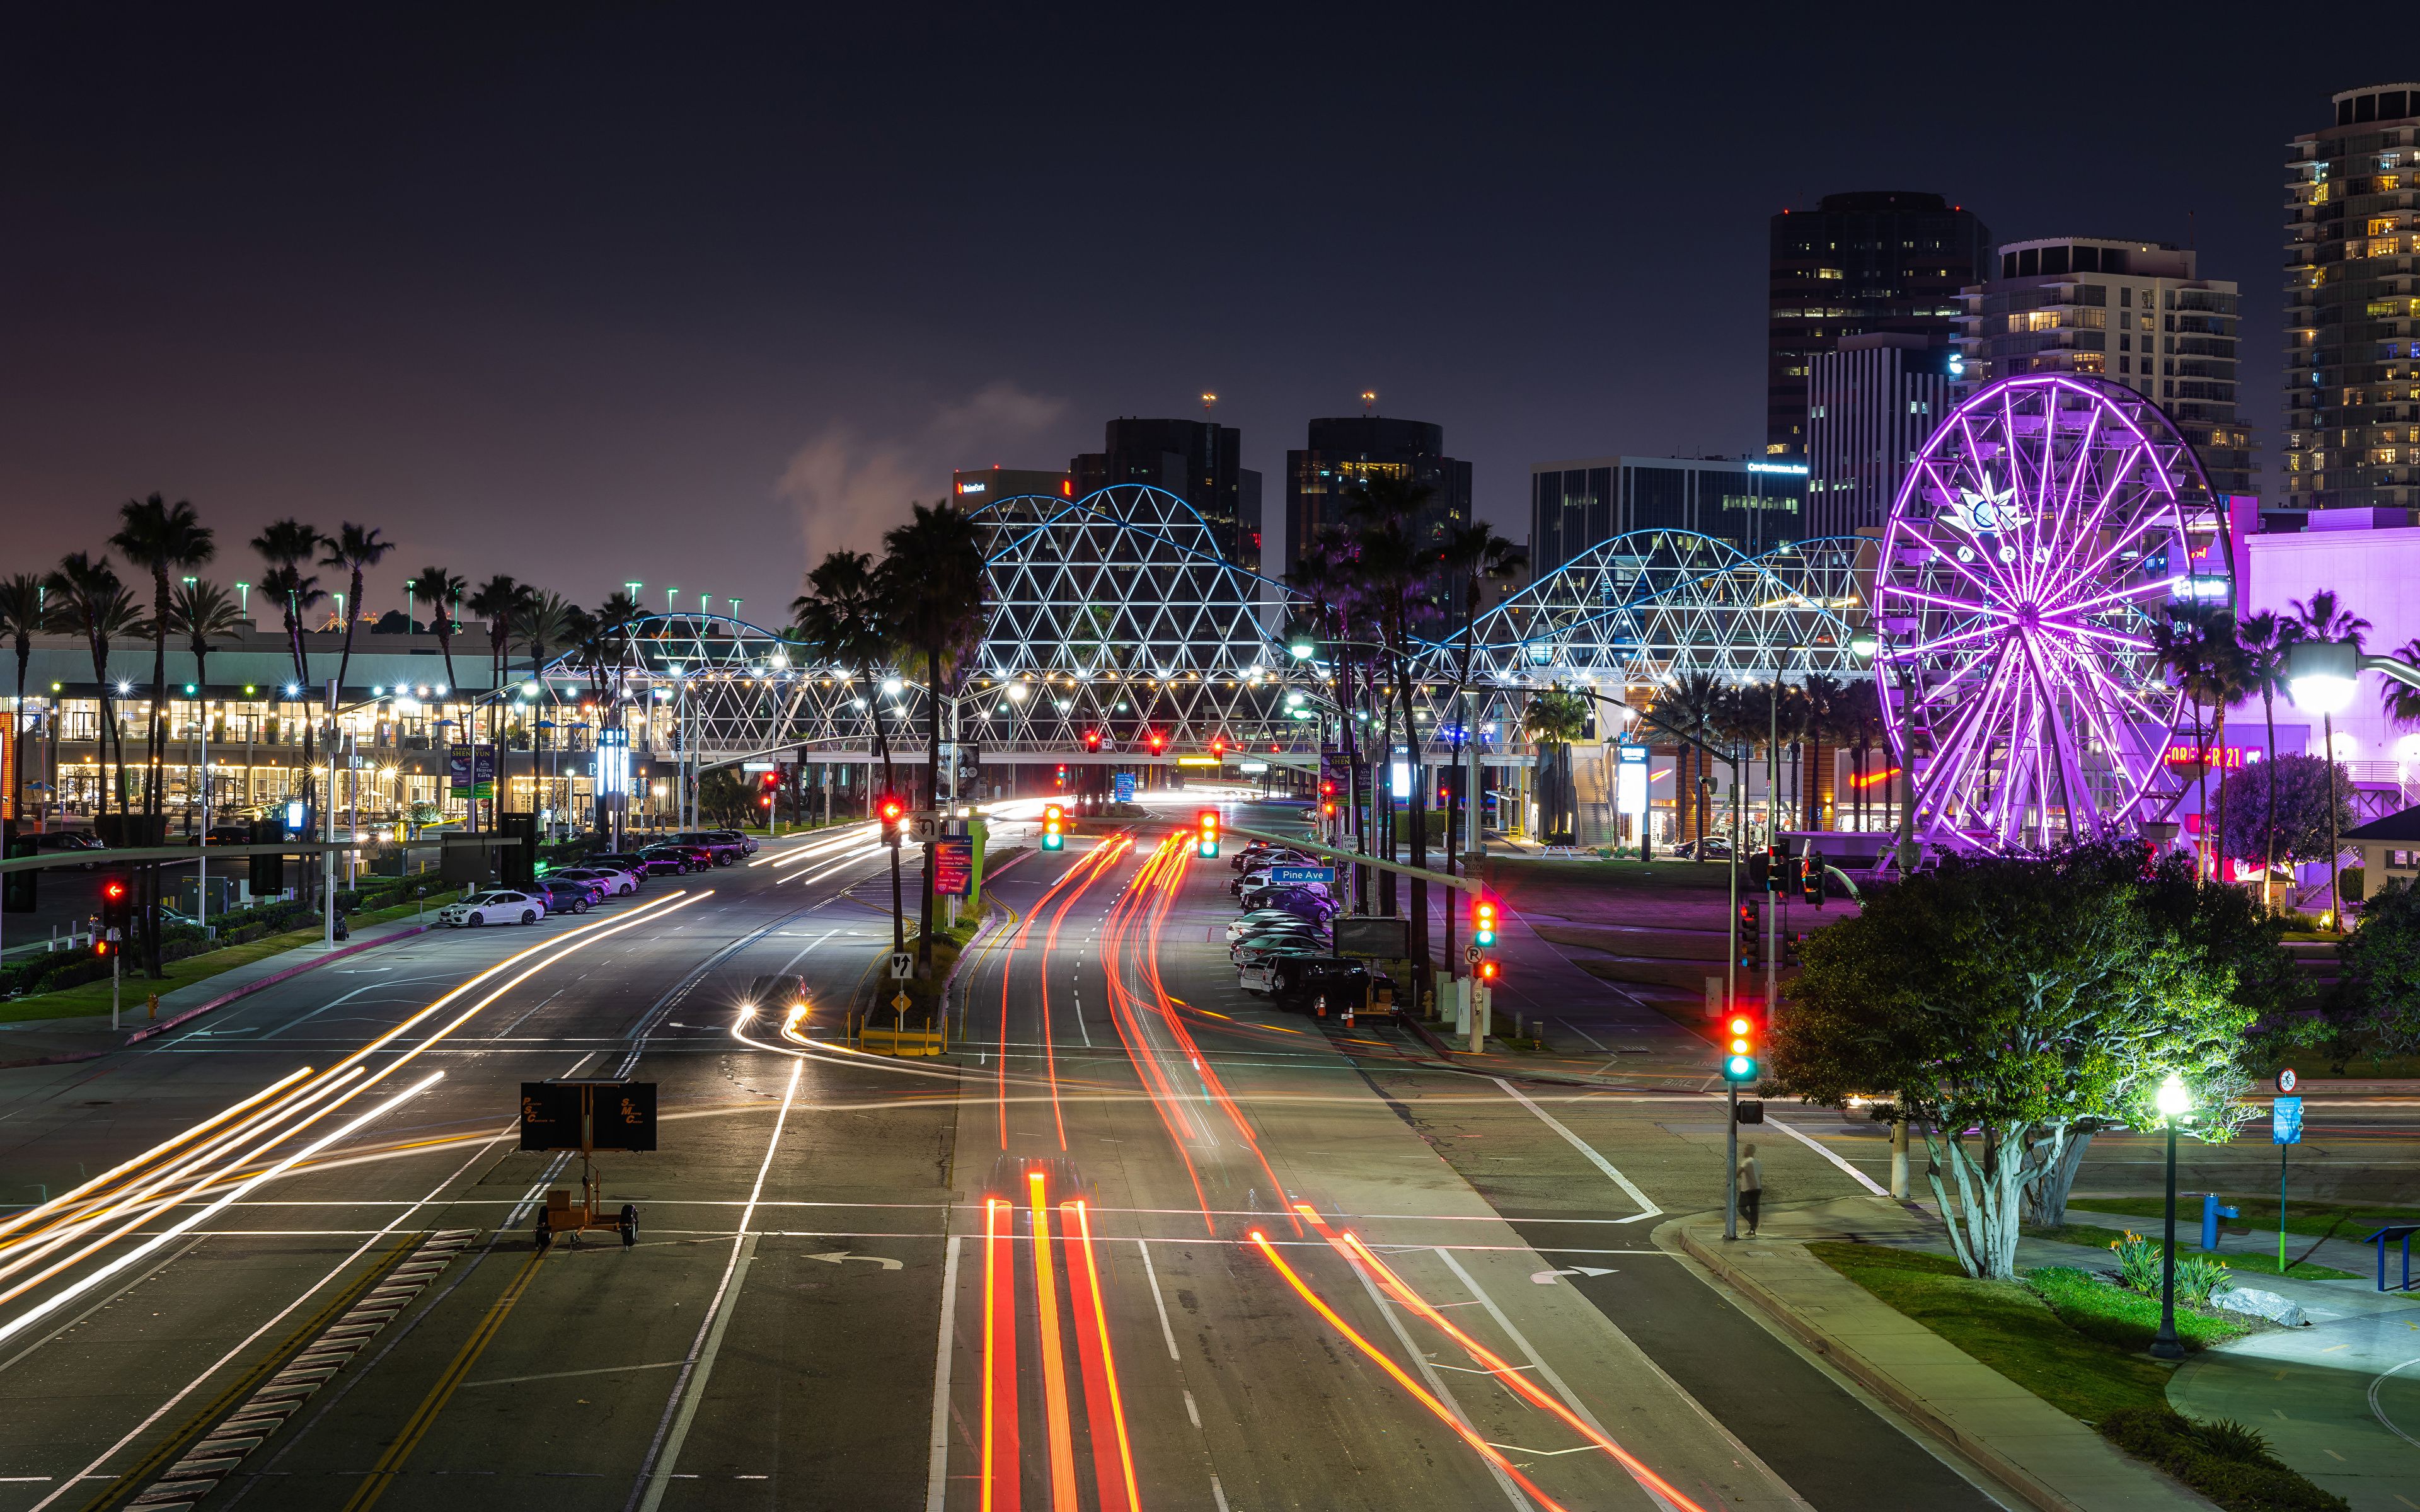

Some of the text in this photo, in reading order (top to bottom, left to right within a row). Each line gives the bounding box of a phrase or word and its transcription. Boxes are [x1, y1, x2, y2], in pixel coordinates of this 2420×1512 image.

[2227, 748, 2239, 767] 21
[1283, 871, 1303, 879] Pine
[1661, 1078, 1697, 1087] BIKE
